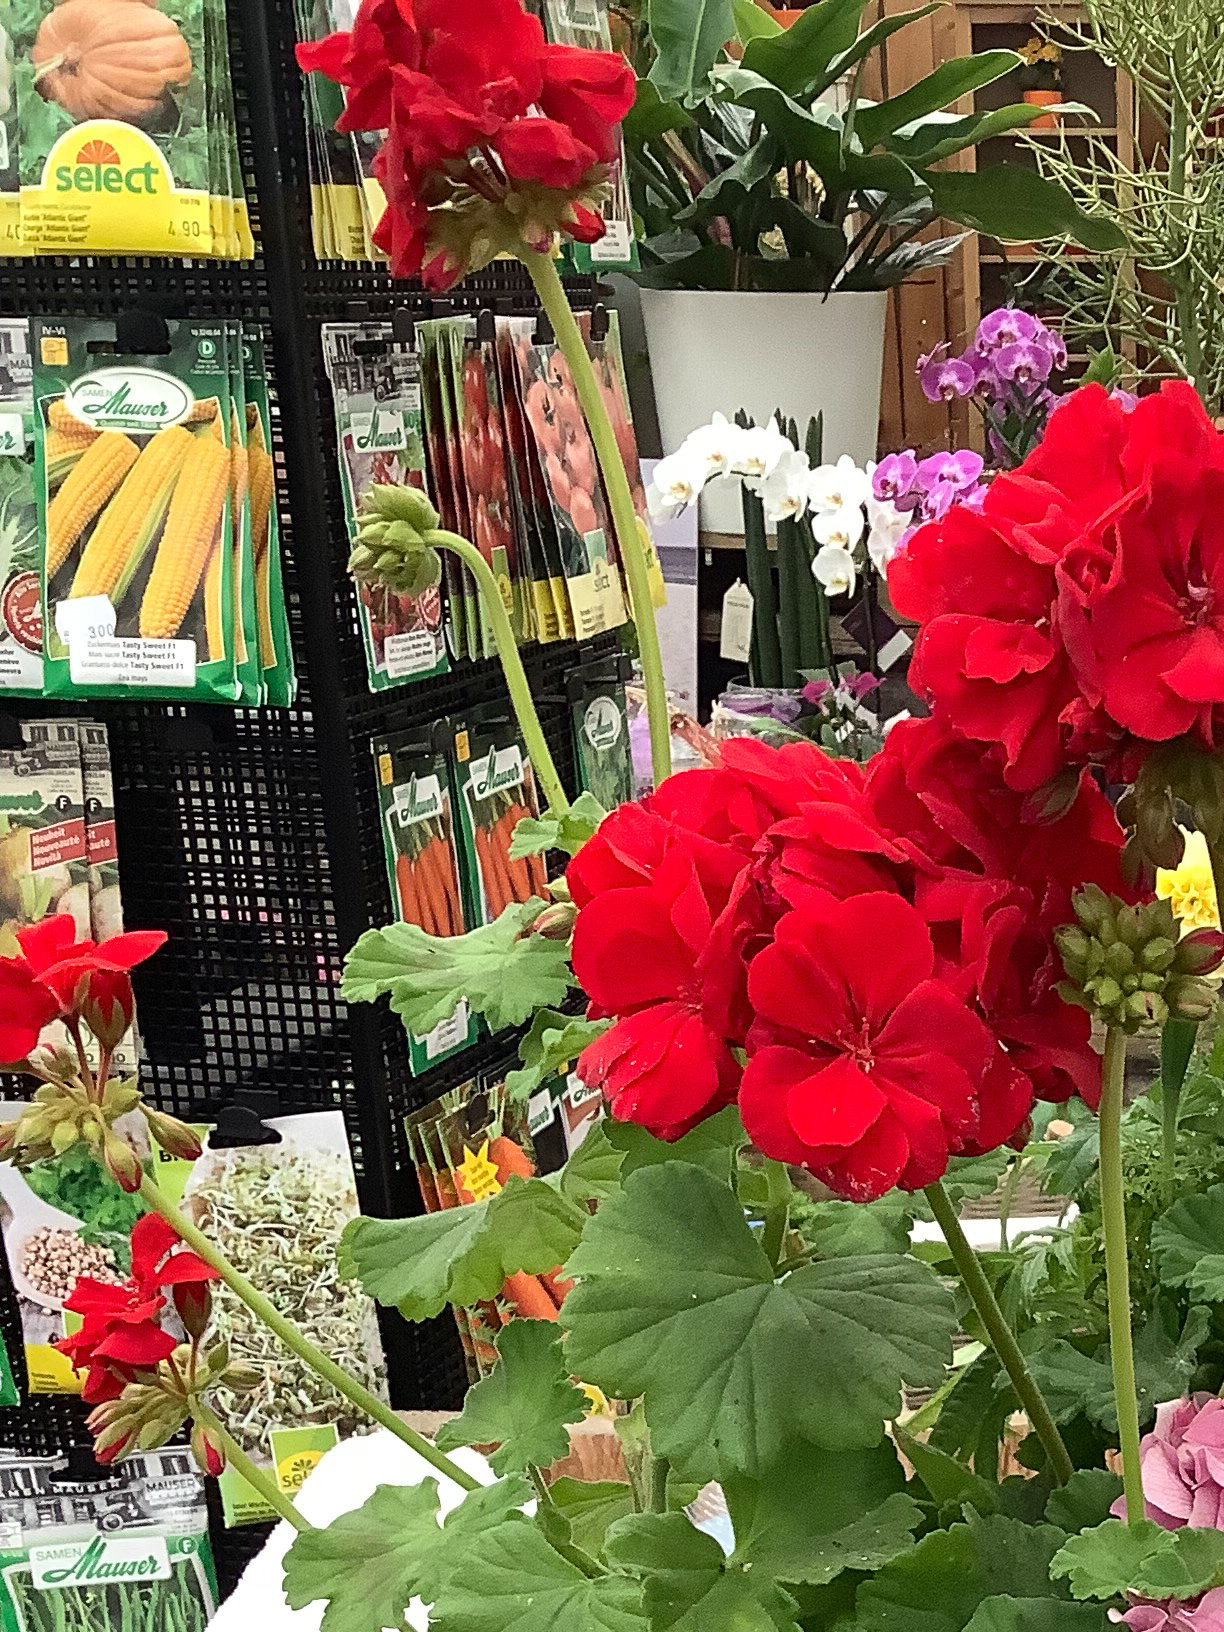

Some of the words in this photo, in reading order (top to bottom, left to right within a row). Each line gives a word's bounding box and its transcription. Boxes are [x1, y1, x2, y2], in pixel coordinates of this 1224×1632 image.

[56, 161, 159, 194] select
[202, 340, 213, 355] D
[82, 388, 113, 398] SAMEN
[82, 381, 169, 416] Mauser
[122, 641, 141, 650] Tasty
[143, 642, 166, 650] Sweet
[122, 651, 141, 660] Tasty
[143, 651, 166, 660] Sweet
[130, 661, 149, 671] Tasty
[151, 662, 174, 671] Sweet
[131, 674, 149, 683] mays
[59, 797, 68, 810] F
[90, 799, 99, 812] F
[32, 827, 66, 845] Neuheit
[32, 835, 80, 857] Nouveauté
[146, 1478, 196, 1492] MAUSER
[181, 1539, 192, 1552] F
[36, 1547, 82, 1562] SAMEN
[42, 1535, 161, 1582] Mauser
